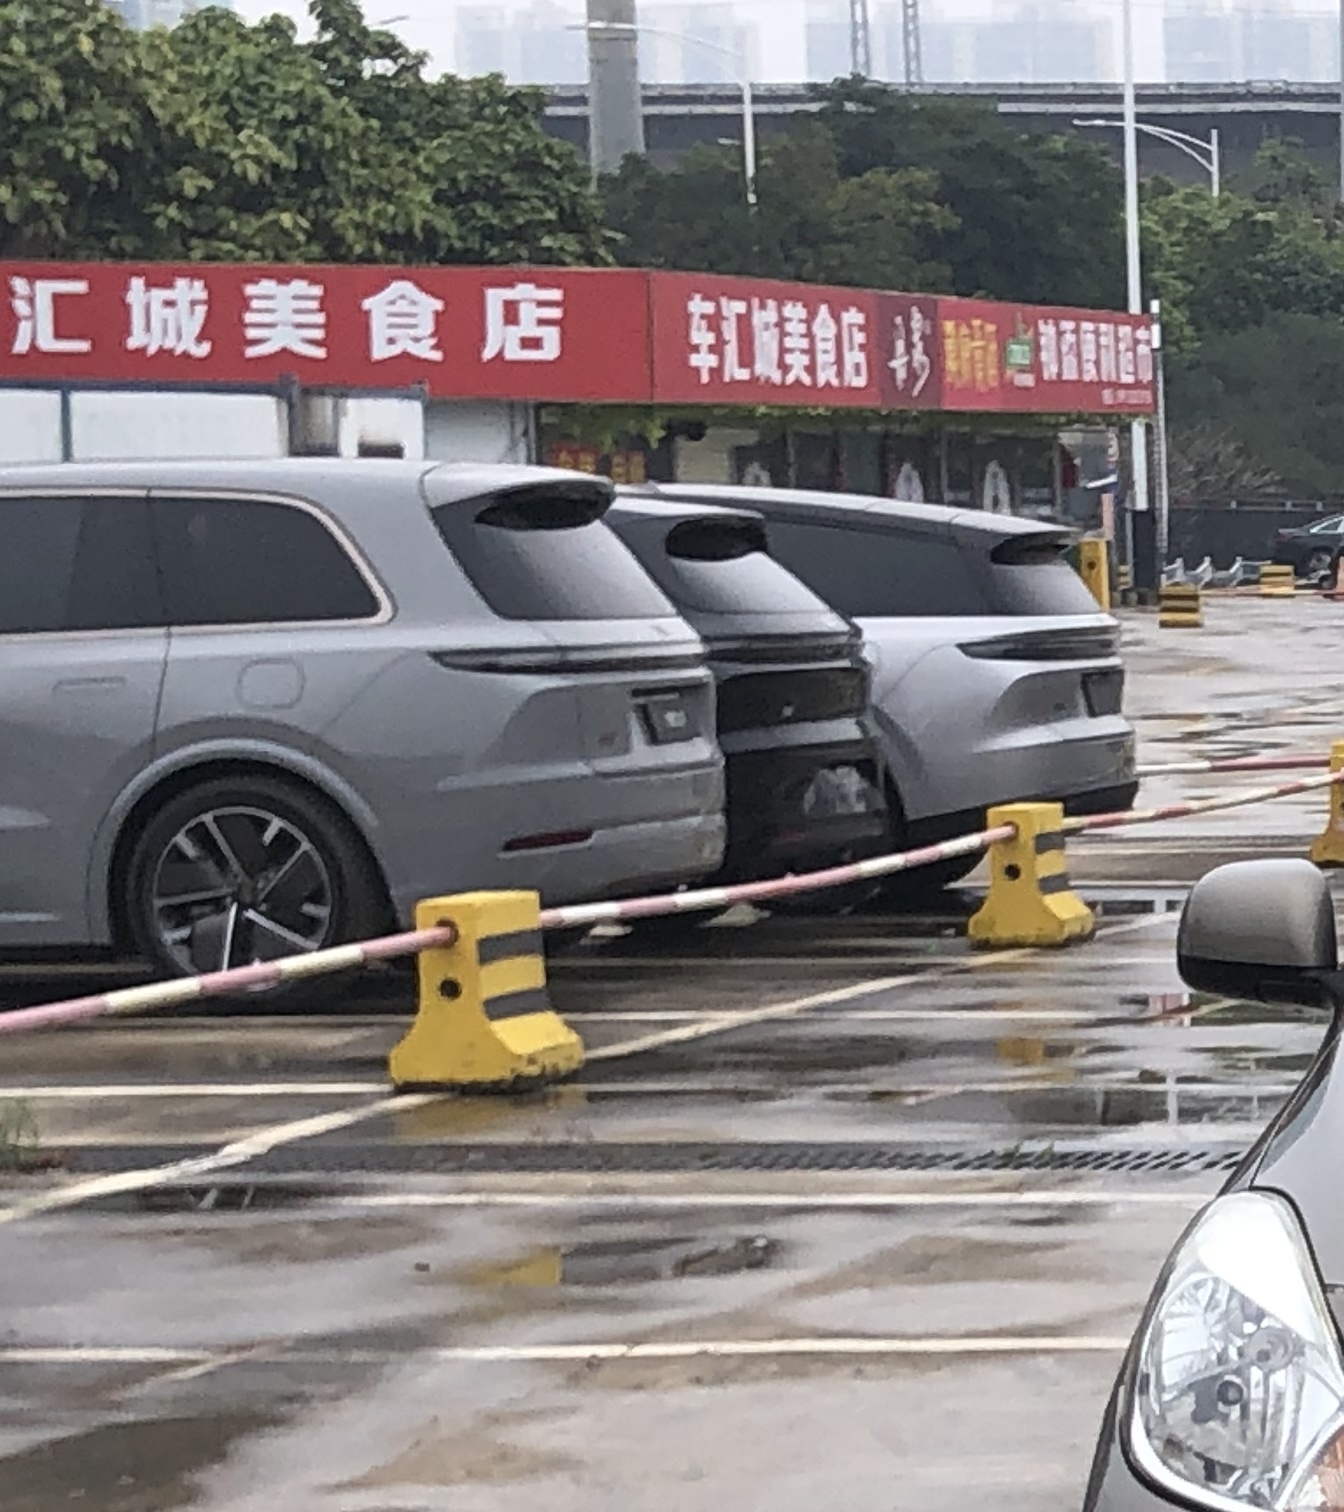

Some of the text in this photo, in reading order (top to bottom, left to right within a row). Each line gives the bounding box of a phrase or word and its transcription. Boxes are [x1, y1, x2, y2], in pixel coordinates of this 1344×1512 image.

[9, 274, 565, 363] 汇城美食店
[687, 292, 868, 388] 车汇城美食店
